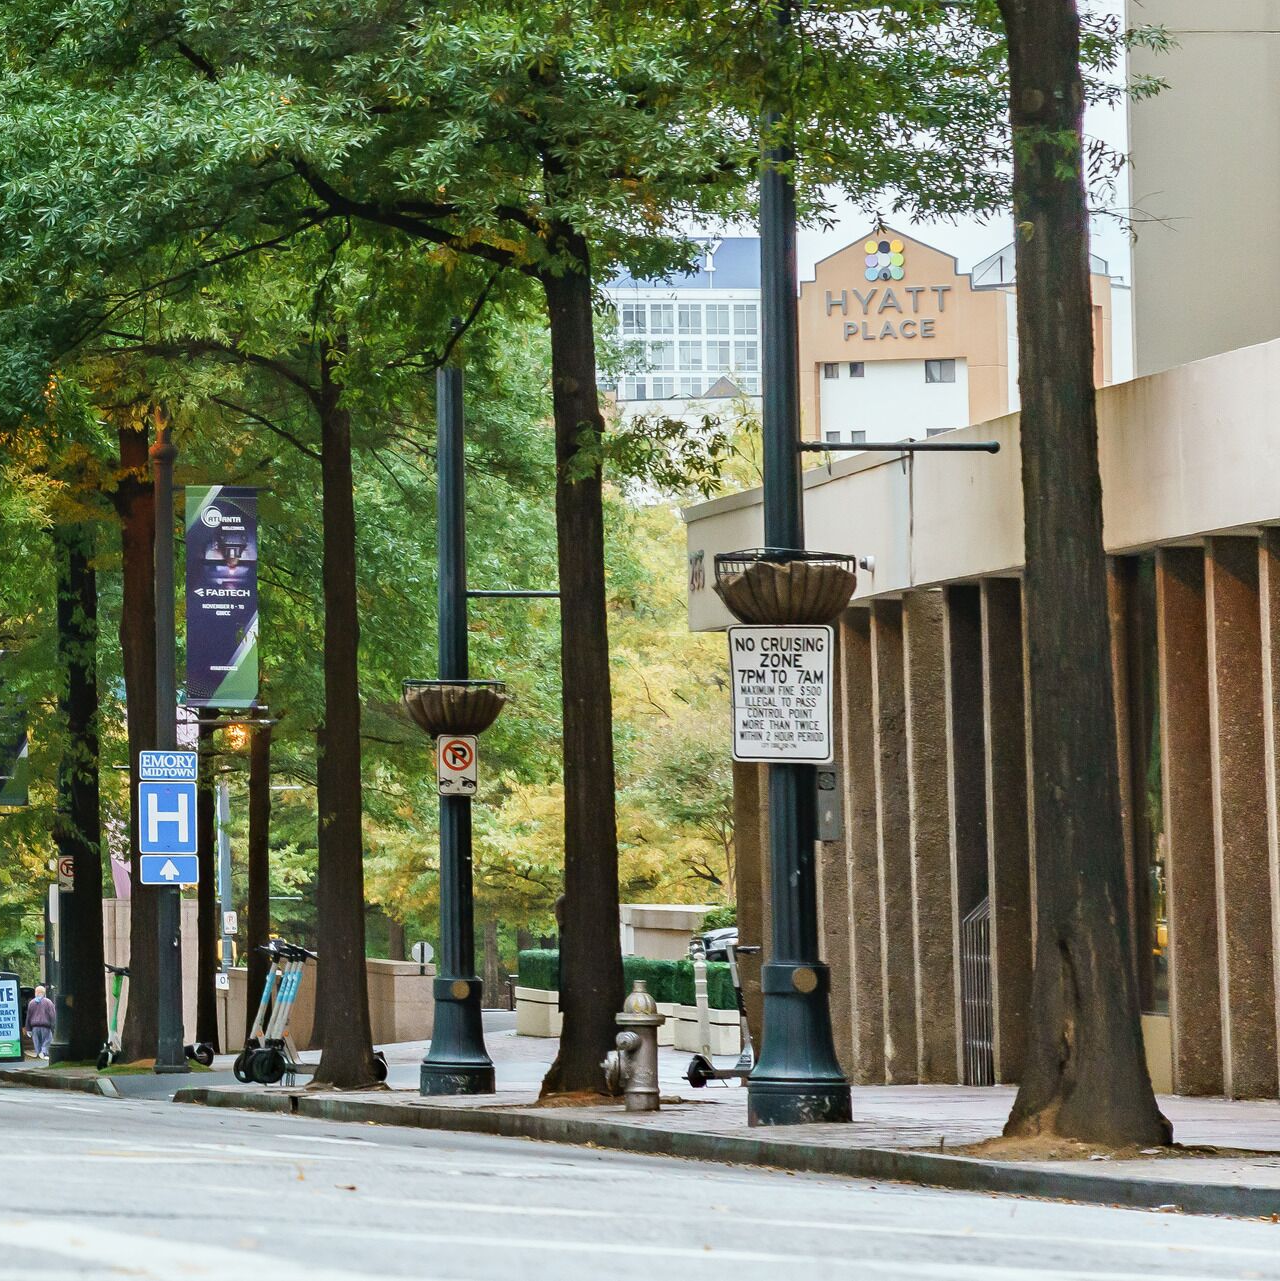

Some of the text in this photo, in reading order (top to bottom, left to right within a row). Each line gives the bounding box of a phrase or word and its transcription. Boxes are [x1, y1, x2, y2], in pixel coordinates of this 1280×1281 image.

[825, 285, 951, 316] HYATT
[843, 318, 936, 342] PLACE
[206, 588, 251, 597] FABTECH
[735, 637, 824, 652] NO CRUISING
[760, 653, 802, 668] ZONE
[738, 669, 824, 684] 7PM TO 7AM
[740, 685, 822, 696] MAXIMUM FINE $500
[745, 697, 816, 708] ILLEGAL TO PASS
[747, 708, 813, 719] CONTROL POINT
[742, 720, 820, 730] MORE THAN TWICE
[739, 731, 824, 742] WITHIN 2 HOUR PERIOD
[142, 754, 195, 768] EMORY
[142, 768, 195, 777] MIDTOWN
[147, 793, 189, 843] H
